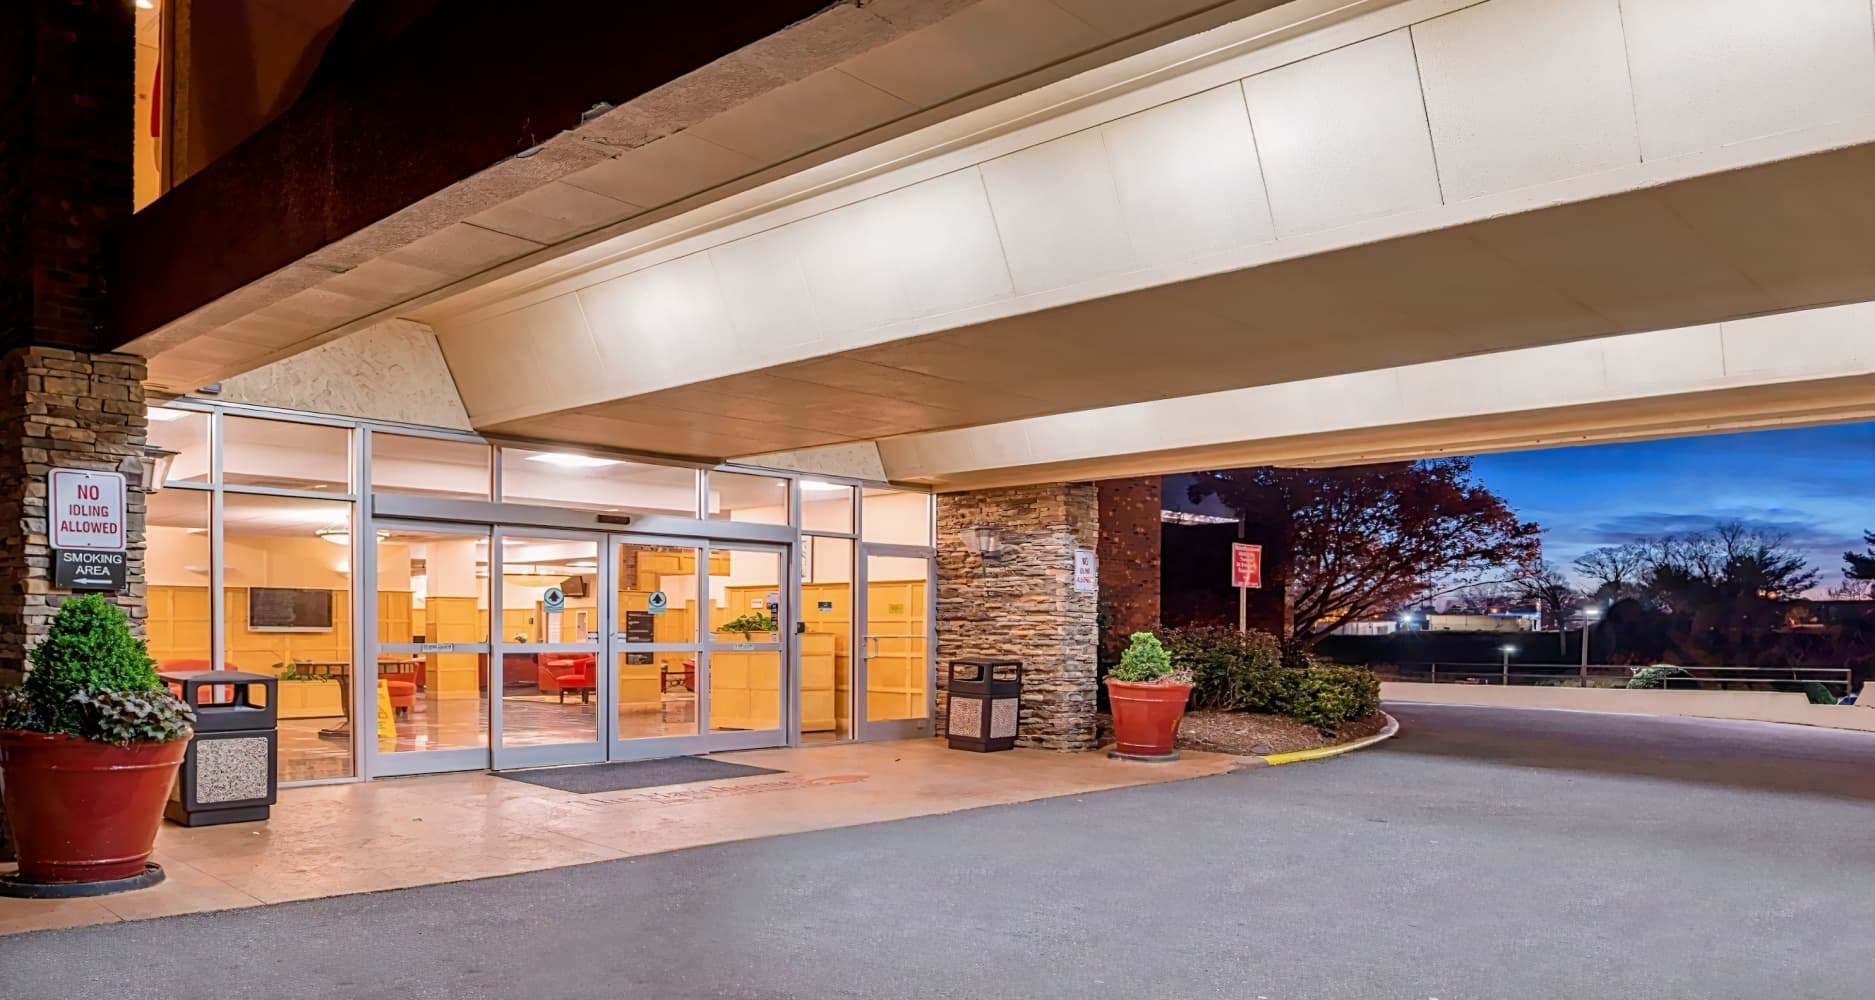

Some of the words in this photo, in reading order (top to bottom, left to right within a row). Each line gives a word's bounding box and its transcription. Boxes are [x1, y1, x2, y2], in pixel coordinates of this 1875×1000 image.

[77, 484, 100, 501] NO
[69, 503, 109, 518] IDLING
[60, 520, 118, 534] ALLOWED
[63, 552, 122, 564] SMOKING
[75, 565, 110, 576] AREA
